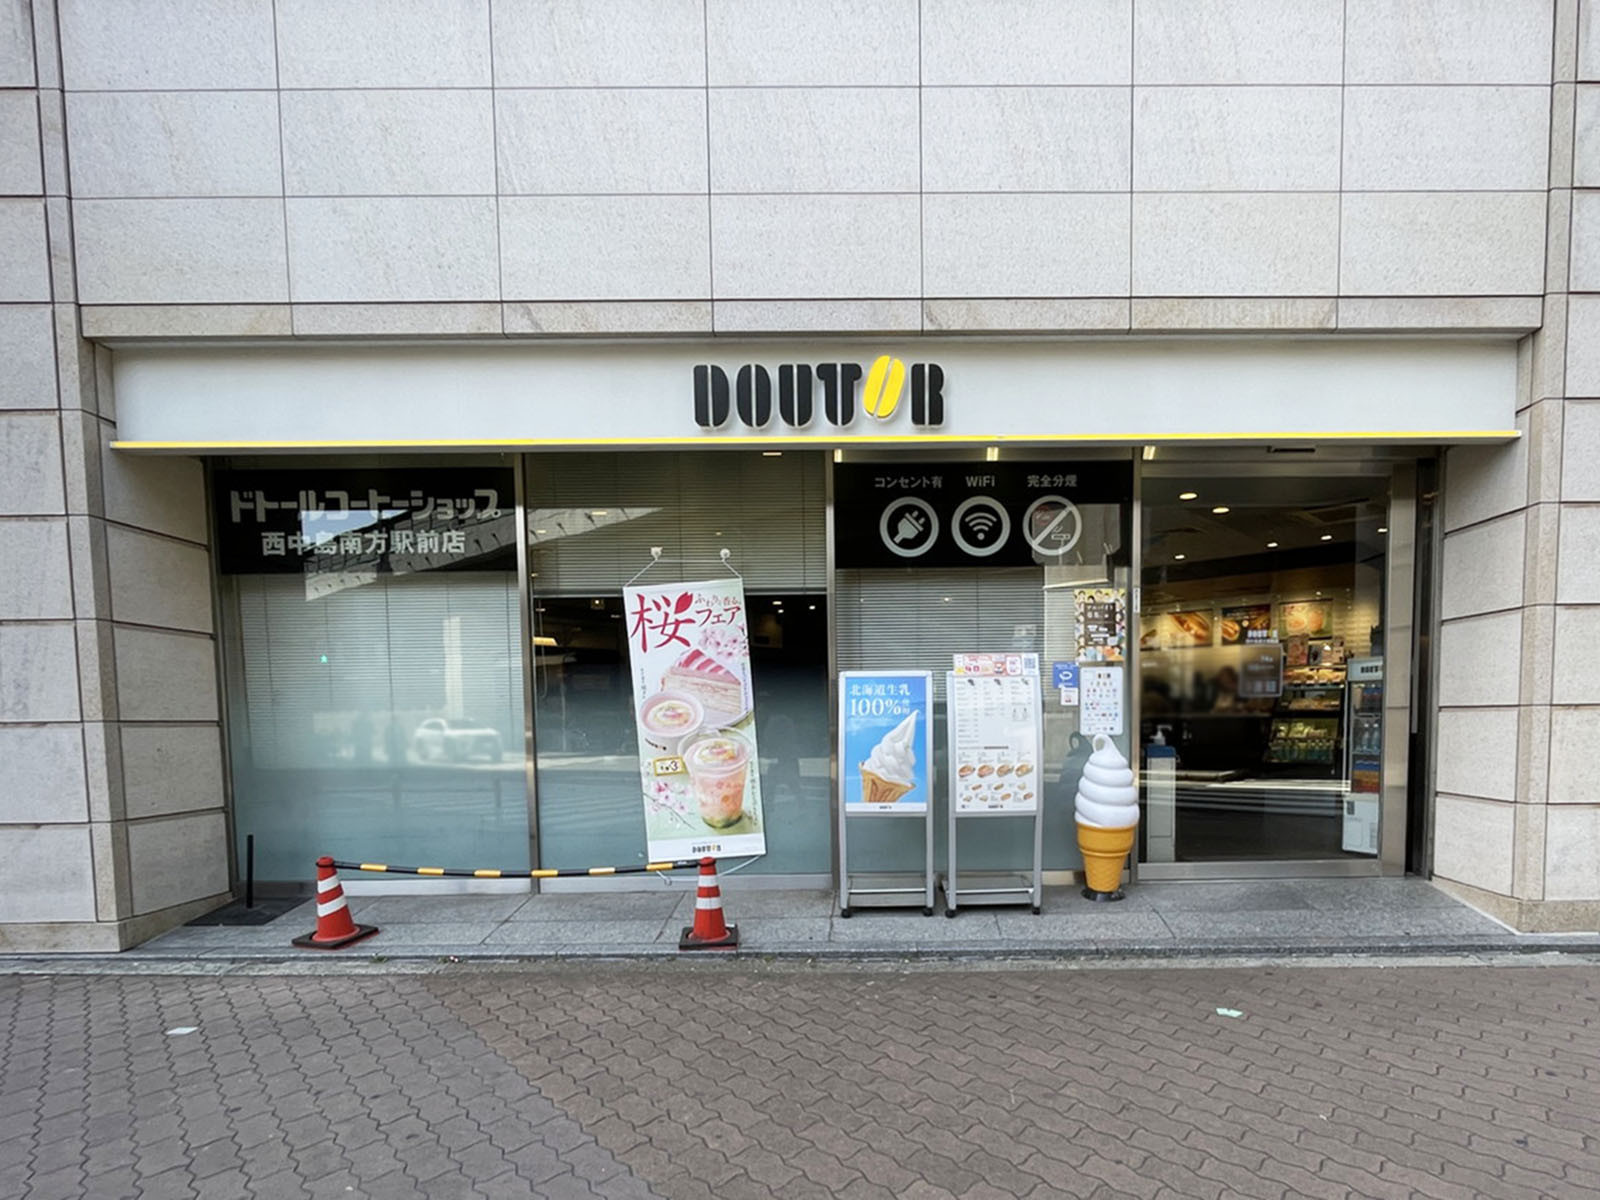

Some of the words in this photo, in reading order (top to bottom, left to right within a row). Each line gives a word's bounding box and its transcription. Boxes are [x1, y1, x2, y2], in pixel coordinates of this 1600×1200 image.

[693, 355, 945, 428] DOUTOR
[874, 475, 943, 489] コンセント有
[965, 474, 996, 488] WiFi
[1027, 474, 1078, 488] 完全分煙
[261, 530, 466, 556] 西中島南方駅前店
[695, 605, 742, 627] フェア
